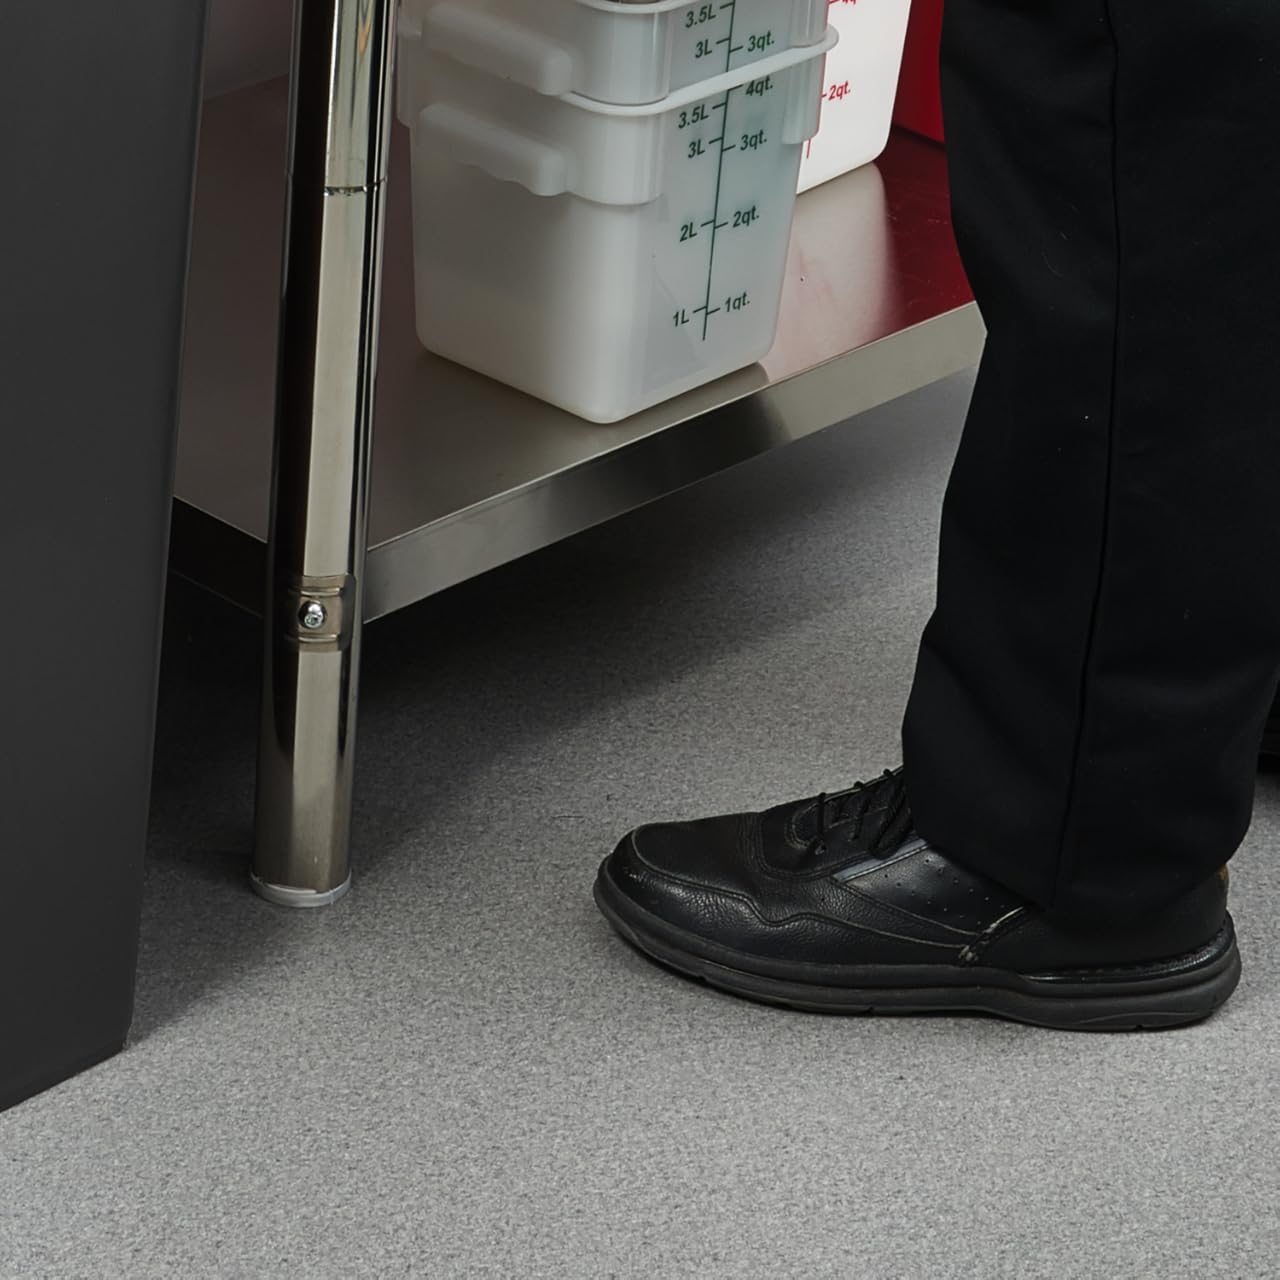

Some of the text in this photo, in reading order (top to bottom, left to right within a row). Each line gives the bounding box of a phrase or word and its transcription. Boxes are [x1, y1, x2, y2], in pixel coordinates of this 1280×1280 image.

[685, 3, 716, 29] 3.5L
[695, 38, 713, 59] 3L
[747, 30, 775, 53] 3qt.
[745, 75, 773, 97] 4qt.
[828, 80, 851, 101] 2qt.
[678, 103, 709, 129] 3.5L
[687, 138, 705, 159] 3L
[740, 129, 767, 152] 3qt.
[732, 205, 759, 228] 2qt.
[679, 222, 697, 243] 2L
[724, 291, 750, 313] 1qt.
[673, 309, 690, 327] 1L
